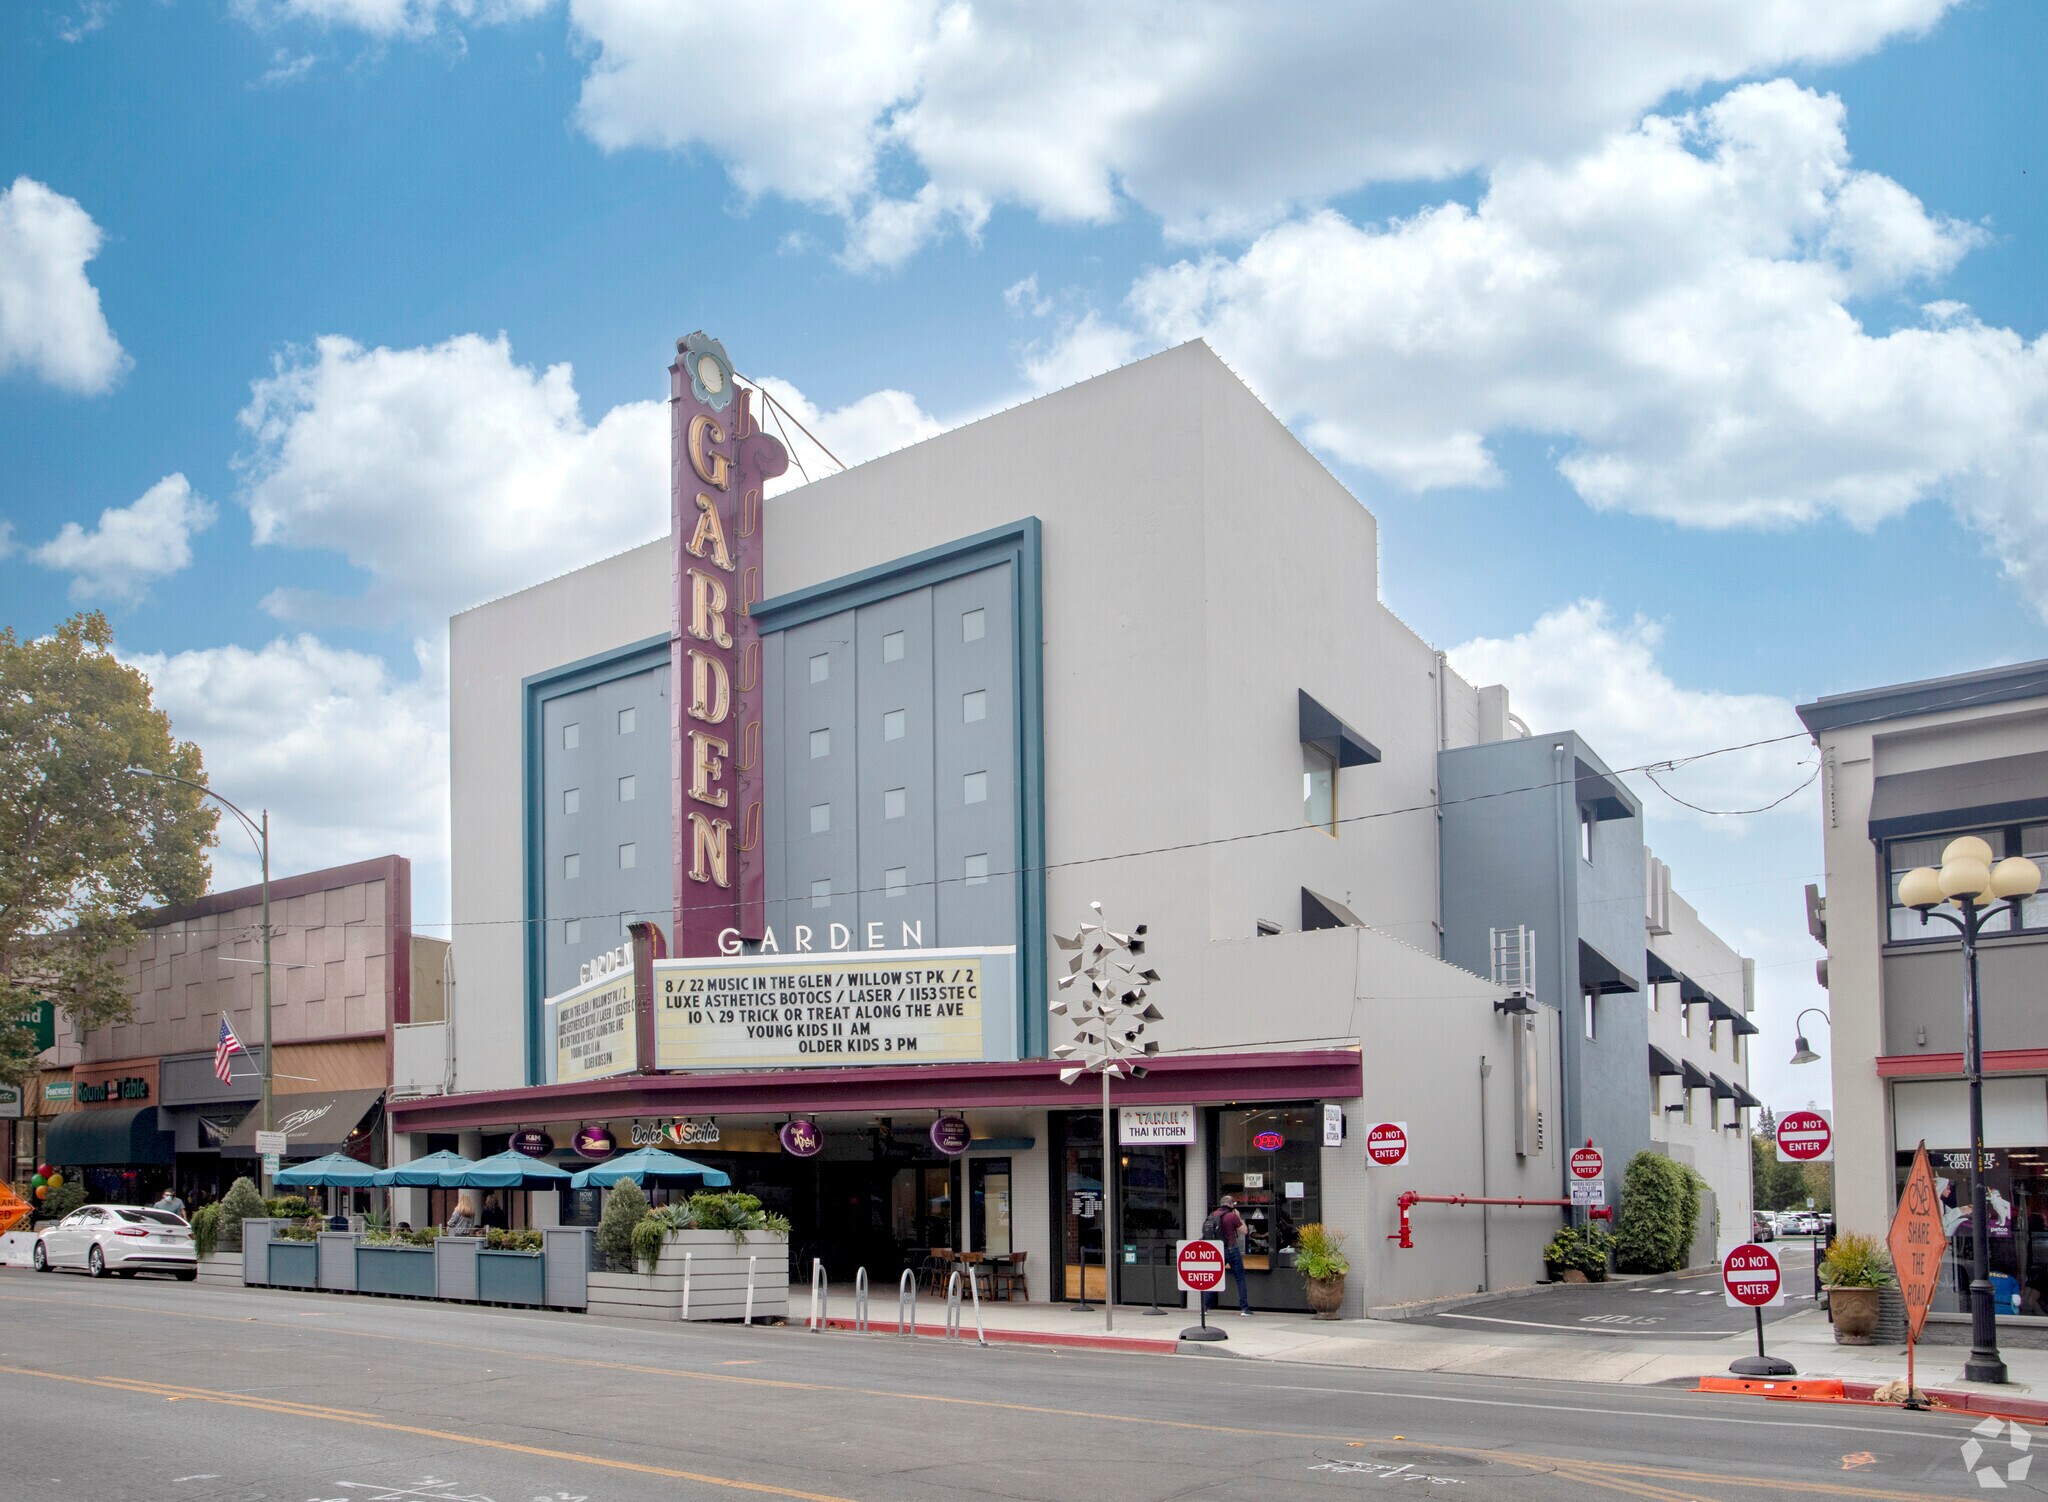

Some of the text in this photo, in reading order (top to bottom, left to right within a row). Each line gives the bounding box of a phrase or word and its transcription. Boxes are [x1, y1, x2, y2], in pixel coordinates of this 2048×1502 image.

[686, 414, 735, 888] GARDEN
[718, 920, 921, 954] GARDEN
[580, 942, 634, 985] GARDEN
[666, 980, 673, 992] 8
[690, 979, 704, 992] 22
[708, 977, 748, 991] MUSIC
[753, 977, 766, 990] IN
[770, 976, 795, 989] THE
[798, 974, 831, 988] GLEN
[848, 972, 902, 986] WILLOW
[906, 971, 922, 984] ST
[927, 970, 944, 984] PK
[966, 969, 973, 982] 2
[666, 995, 699, 1009] LUXE
[705, 992, 776, 1008] ASTHETICS
[780, 991, 831, 1005] BOTOCS
[850, 989, 891, 1003] LASER
[911, 987, 937, 1000] 1153
[939, 986, 964, 1000] STE
[968, 986, 977, 999] C
[600, 1010, 611, 1022] LASER
[688, 1011, 702, 1024] 10
[720, 1010, 734, 1023] 29
[739, 1009, 778, 1022] TRICK
[784, 1008, 802, 1021] OR
[807, 1007, 850, 1020] TREAT
[855, 1005, 900, 1019] ALONG
[906, 1004, 931, 1017] THE
[937, 1003, 964, 1016] AVE
[571, 1033, 580, 1046] TRICK
[586, 1028, 595, 1040] TREAT
[747, 1025, 792, 1038] YOUNG
[797, 1023, 828, 1037] KIDS
[851, 1022, 870, 1035] AM
[799, 1038, 917, 1053] OLDER KIDS 3 PM
[78, 1078, 147, 1102] Round Table
[632, 1120, 720, 1145] Dolce Sicilia
[1129, 1127, 1186, 1136] THAI KITCHEN
[1785, 1120, 1822, 1130] DO NOT
[1253, 1135, 1283, 1148] OPEN
[1372, 1130, 1401, 1140] DO NOT
[1375, 1149, 1400, 1158] ENTER
[1789, 1142, 1820, 1151] ENTER
[1943, 1153, 1970, 1162] SCARY
[1908, 1221, 1930, 1245] SHARE
[1185, 1251, 1216, 1260] DO NOT
[1731, 1256, 1768, 1268] DO NOT
[1912, 1252, 1925, 1275] THE
[1188, 1273, 1214, 1281] ENTER
[1737, 1284, 1769, 1295] ENTER
[1907, 1284, 1925, 1306] ROAD
[1579, 1314, 1666, 1325] STOP
